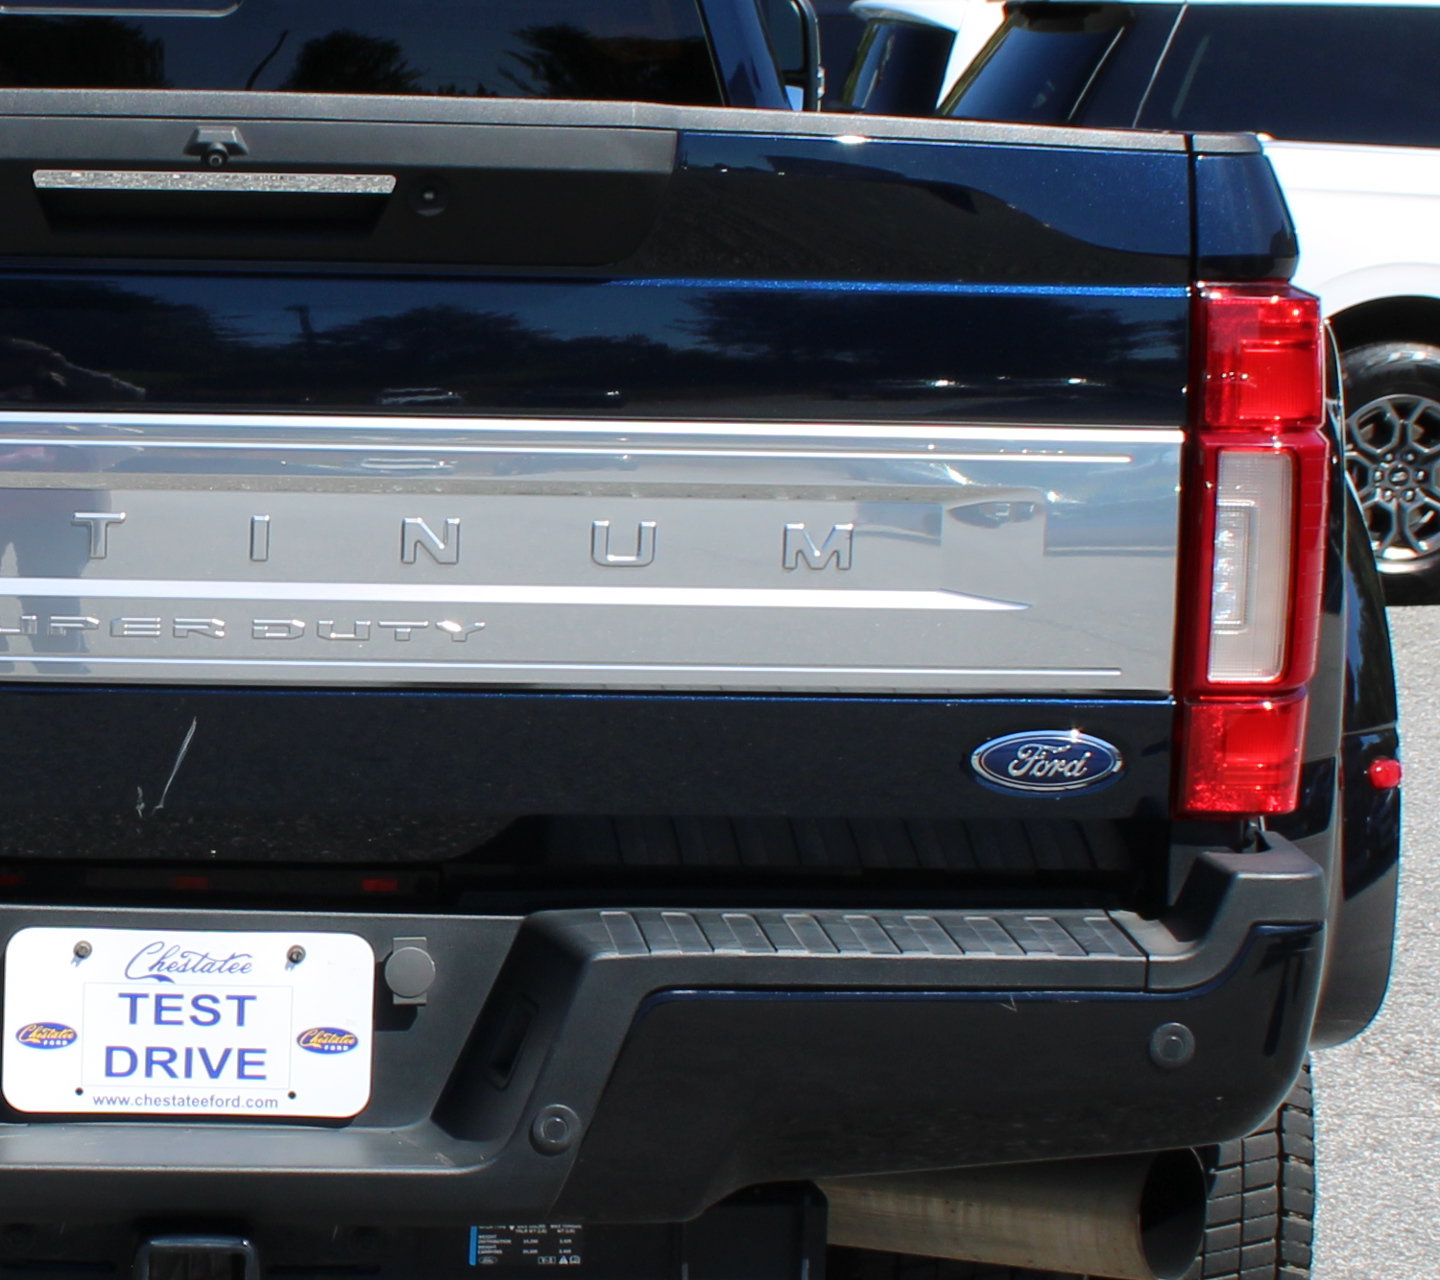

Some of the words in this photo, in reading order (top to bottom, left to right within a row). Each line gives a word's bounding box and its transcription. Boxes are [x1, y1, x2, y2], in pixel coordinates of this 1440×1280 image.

[251, 617, 486, 643] DUTY
[1007, 742, 1092, 778] Ford
[123, 940, 253, 984] Chestatee
[117, 992, 258, 1028] TEST
[103, 1045, 268, 1081] DRIVE
[92, 1093, 279, 1110] www.chestateeford.com
